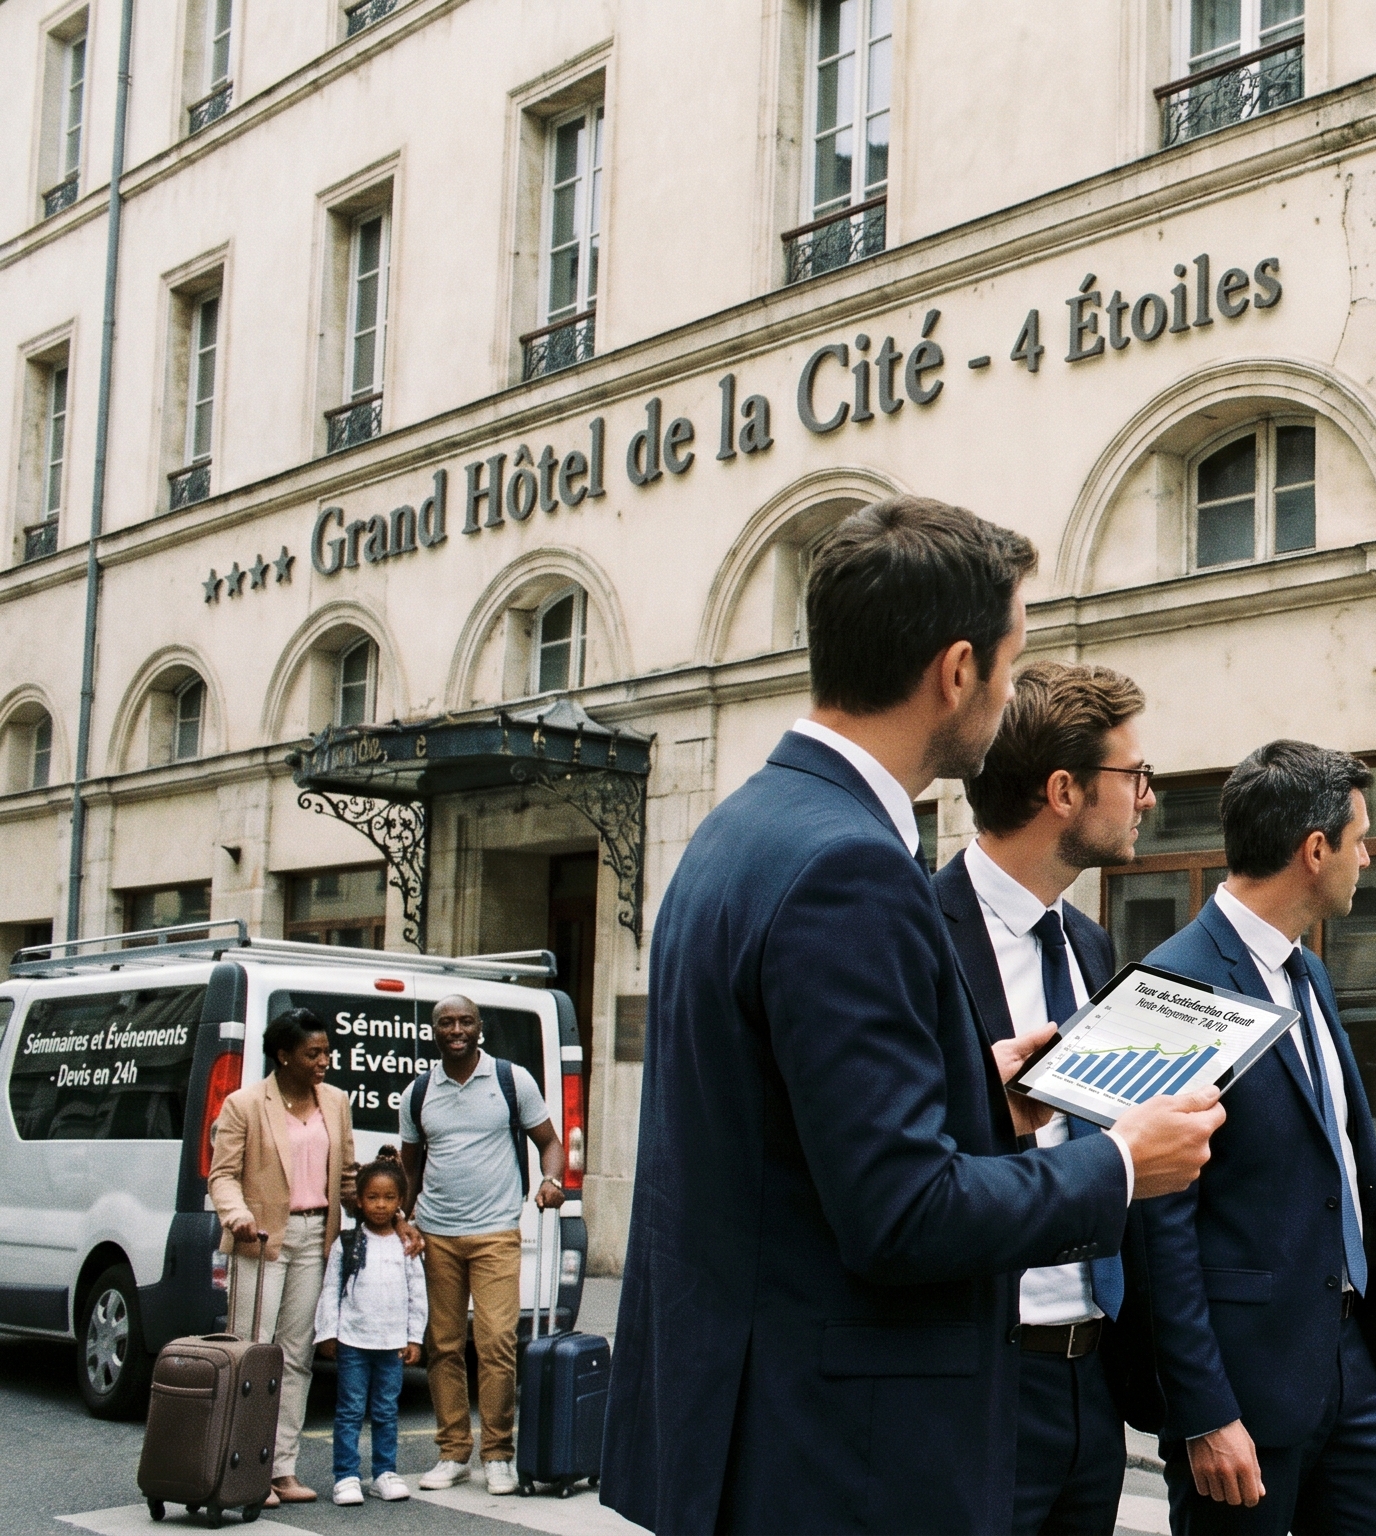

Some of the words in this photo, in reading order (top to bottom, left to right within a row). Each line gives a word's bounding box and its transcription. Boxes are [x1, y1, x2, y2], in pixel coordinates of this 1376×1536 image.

[311, 469, 448, 576] Grand
[462, 416, 606, 535] Hôtel
[626, 397, 695, 486] de
[716, 373, 774, 461] la
[796, 308, 944, 435] Cité
[968, 355, 991, 369] -
[1010, 309, 1045, 373] 4
[1064, 253, 1283, 363] Étoiles
[24, 1029, 89, 1054] Séminaires
[90, 1030, 104, 1050] et
[105, 1022, 188, 1050] Événements
[335, 1011, 485, 1045] Sémina
[57, 1063, 91, 1087] Devis
[93, 1066, 110, 1085] en
[112, 1058, 138, 1085] 24h
[326, 1048, 341, 1070] t
[351, 1042, 443, 1075] Événe
